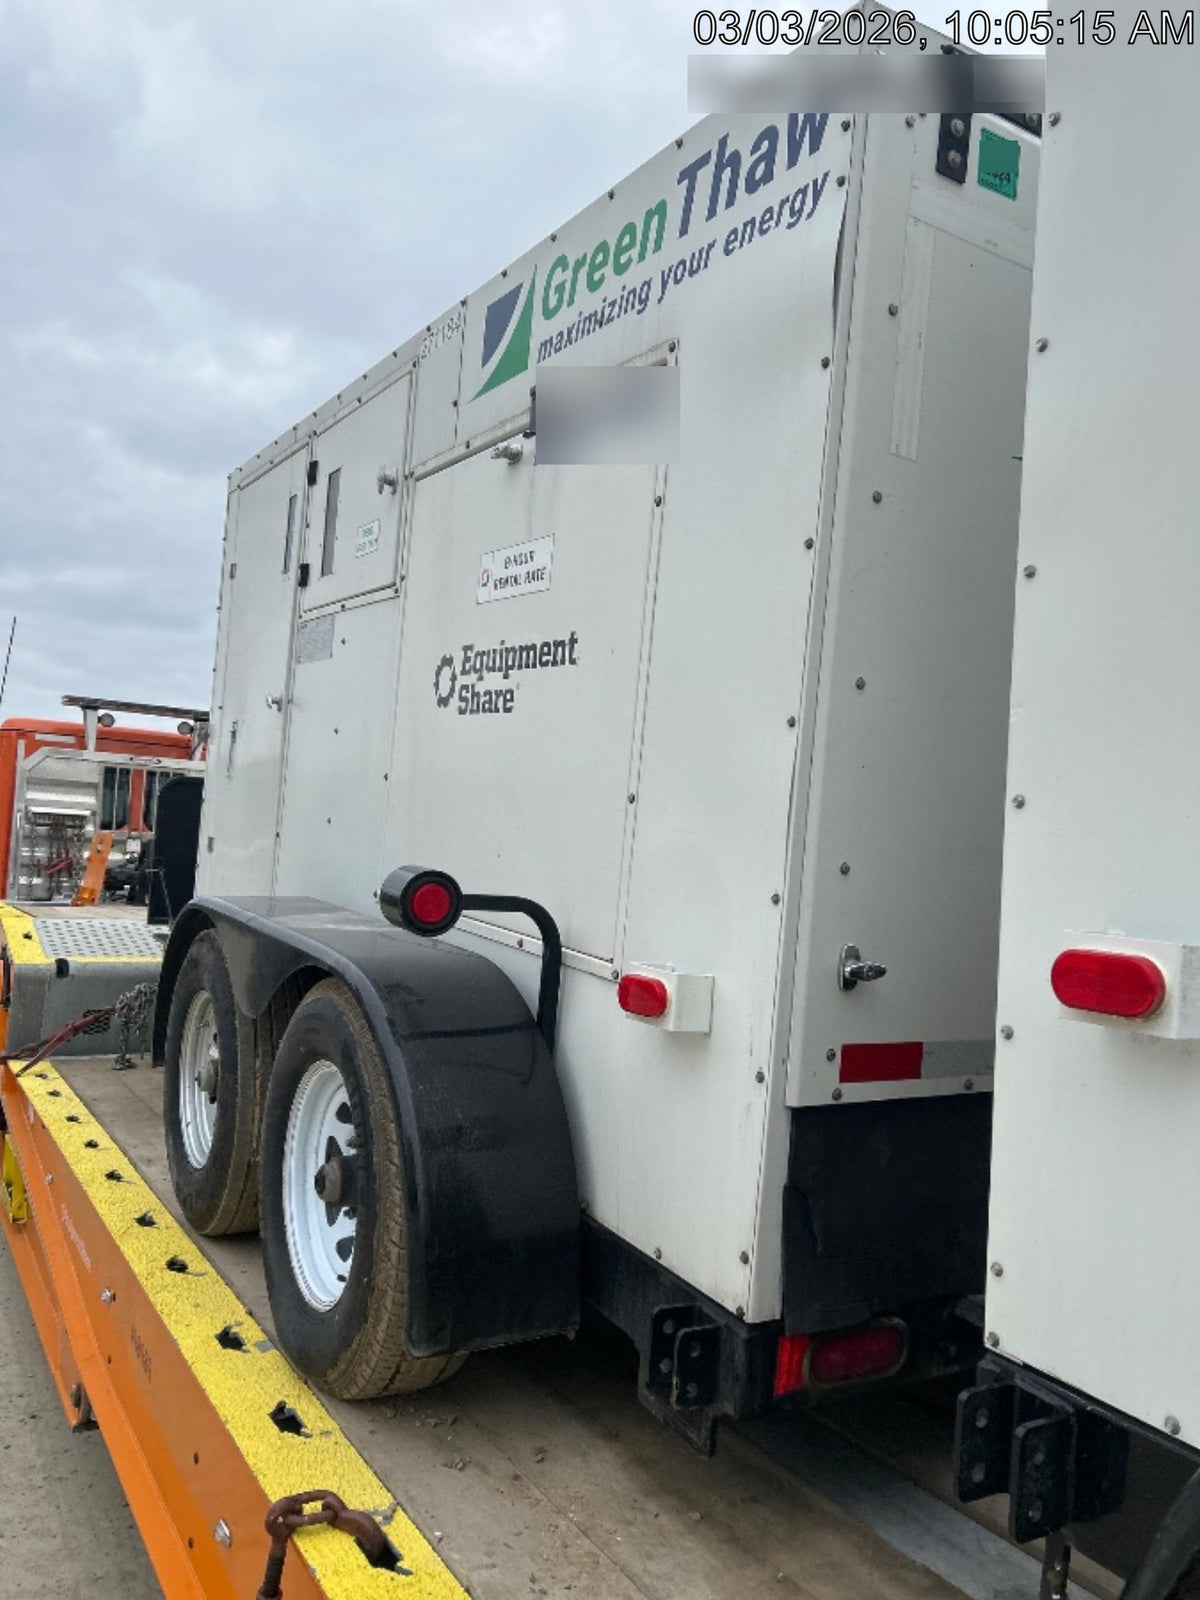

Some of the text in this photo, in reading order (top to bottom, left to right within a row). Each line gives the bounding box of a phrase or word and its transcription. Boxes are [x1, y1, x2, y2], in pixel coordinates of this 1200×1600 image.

[536, 170, 831, 364] maximizing your energy
[459, 630, 579, 681] Equipment
[457, 683, 515, 716] Share
